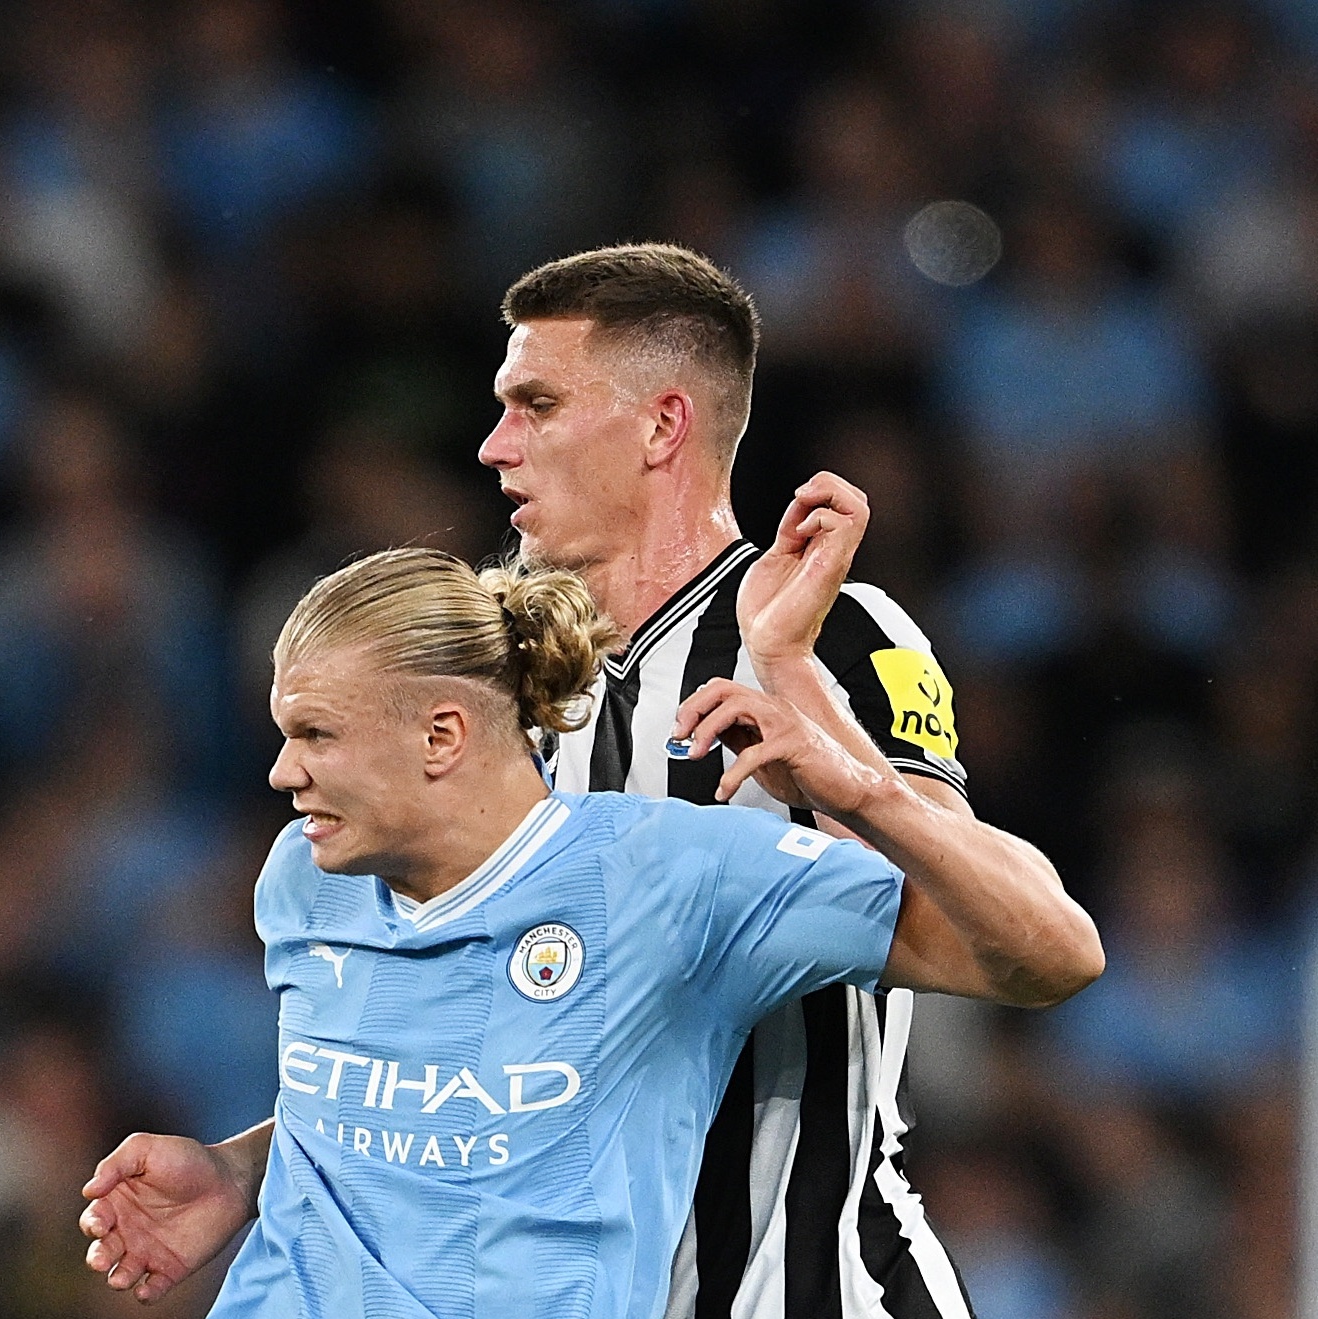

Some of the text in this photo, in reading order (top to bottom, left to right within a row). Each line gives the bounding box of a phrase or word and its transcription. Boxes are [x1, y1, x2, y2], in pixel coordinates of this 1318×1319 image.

[518, 926, 579, 954] MANCHESTER
[533, 988, 557, 997] CITY
[281, 1041, 582, 1115] ETIHAD
